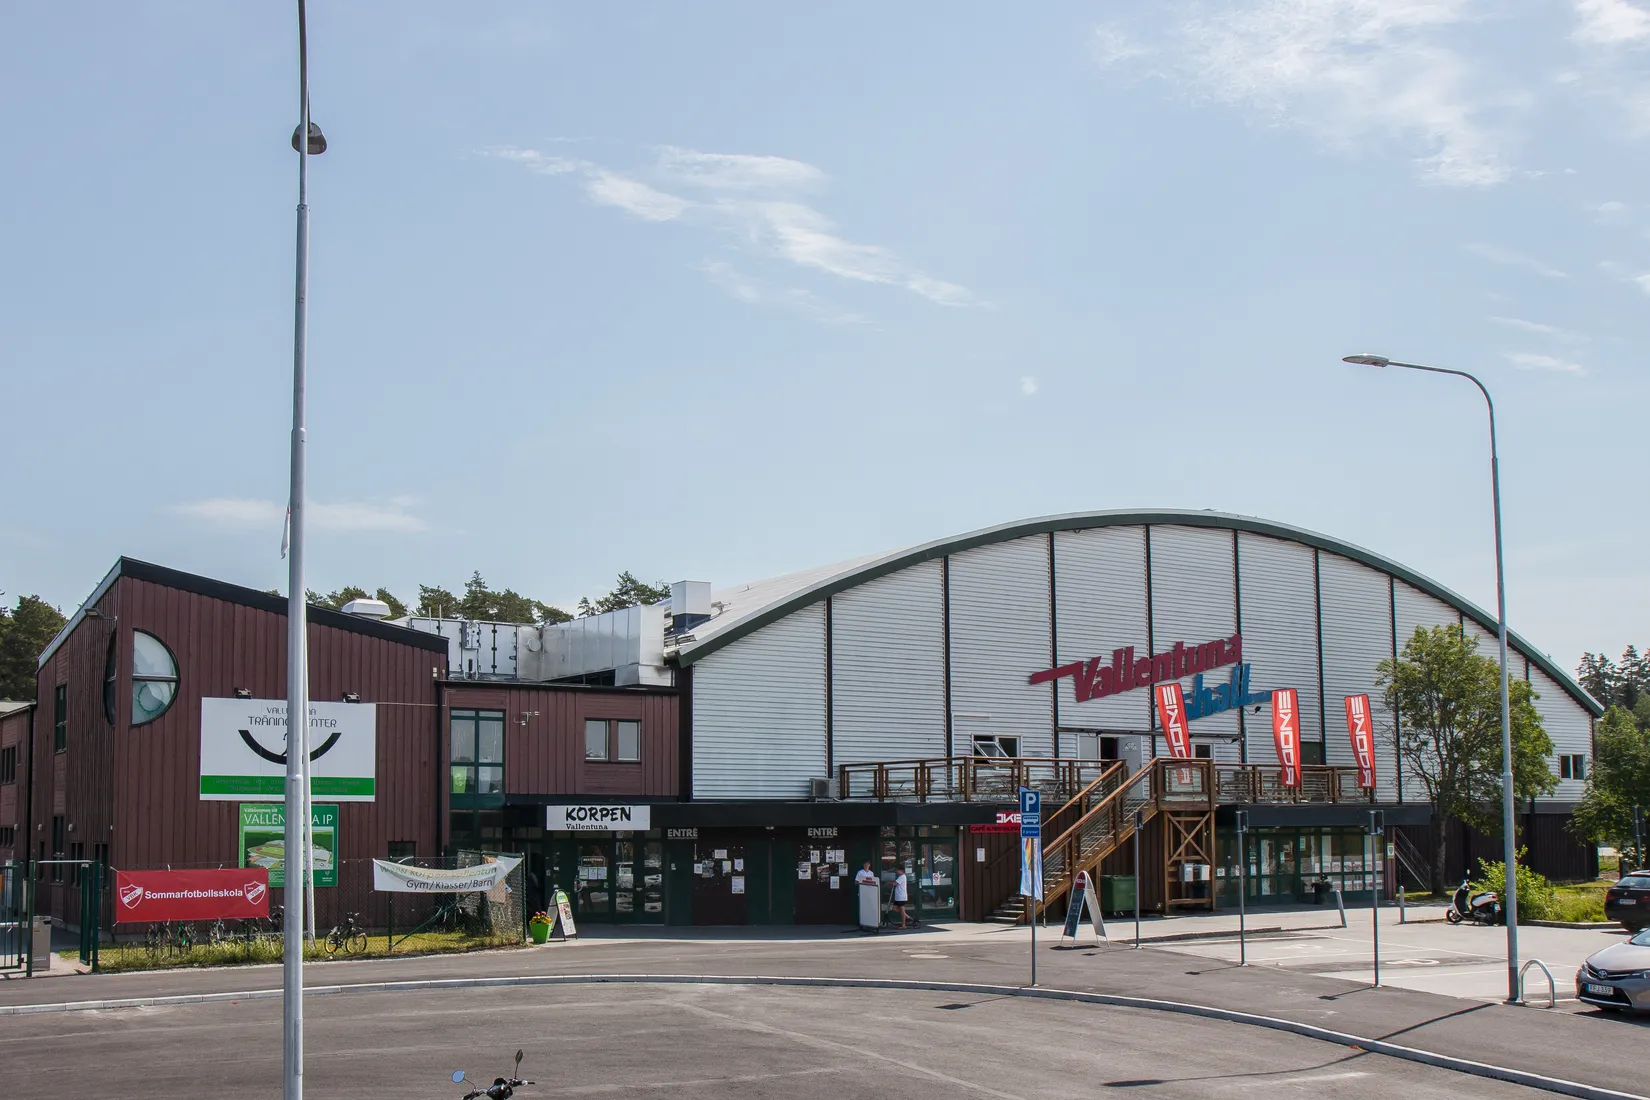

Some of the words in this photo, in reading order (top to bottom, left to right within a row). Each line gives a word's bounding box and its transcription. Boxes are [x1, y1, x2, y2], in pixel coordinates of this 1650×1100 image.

[1030, 633, 1242, 703] Vallentuna
[1025, 792, 1036, 812] P
[322, 814, 333, 825] IP
[565, 806, 632, 822] KORPEN
[667, 826, 698, 837] ENTRÉ
[807, 826, 838, 837] ENTRÉ
[144, 889, 243, 900] Sommarfotbollsskola
